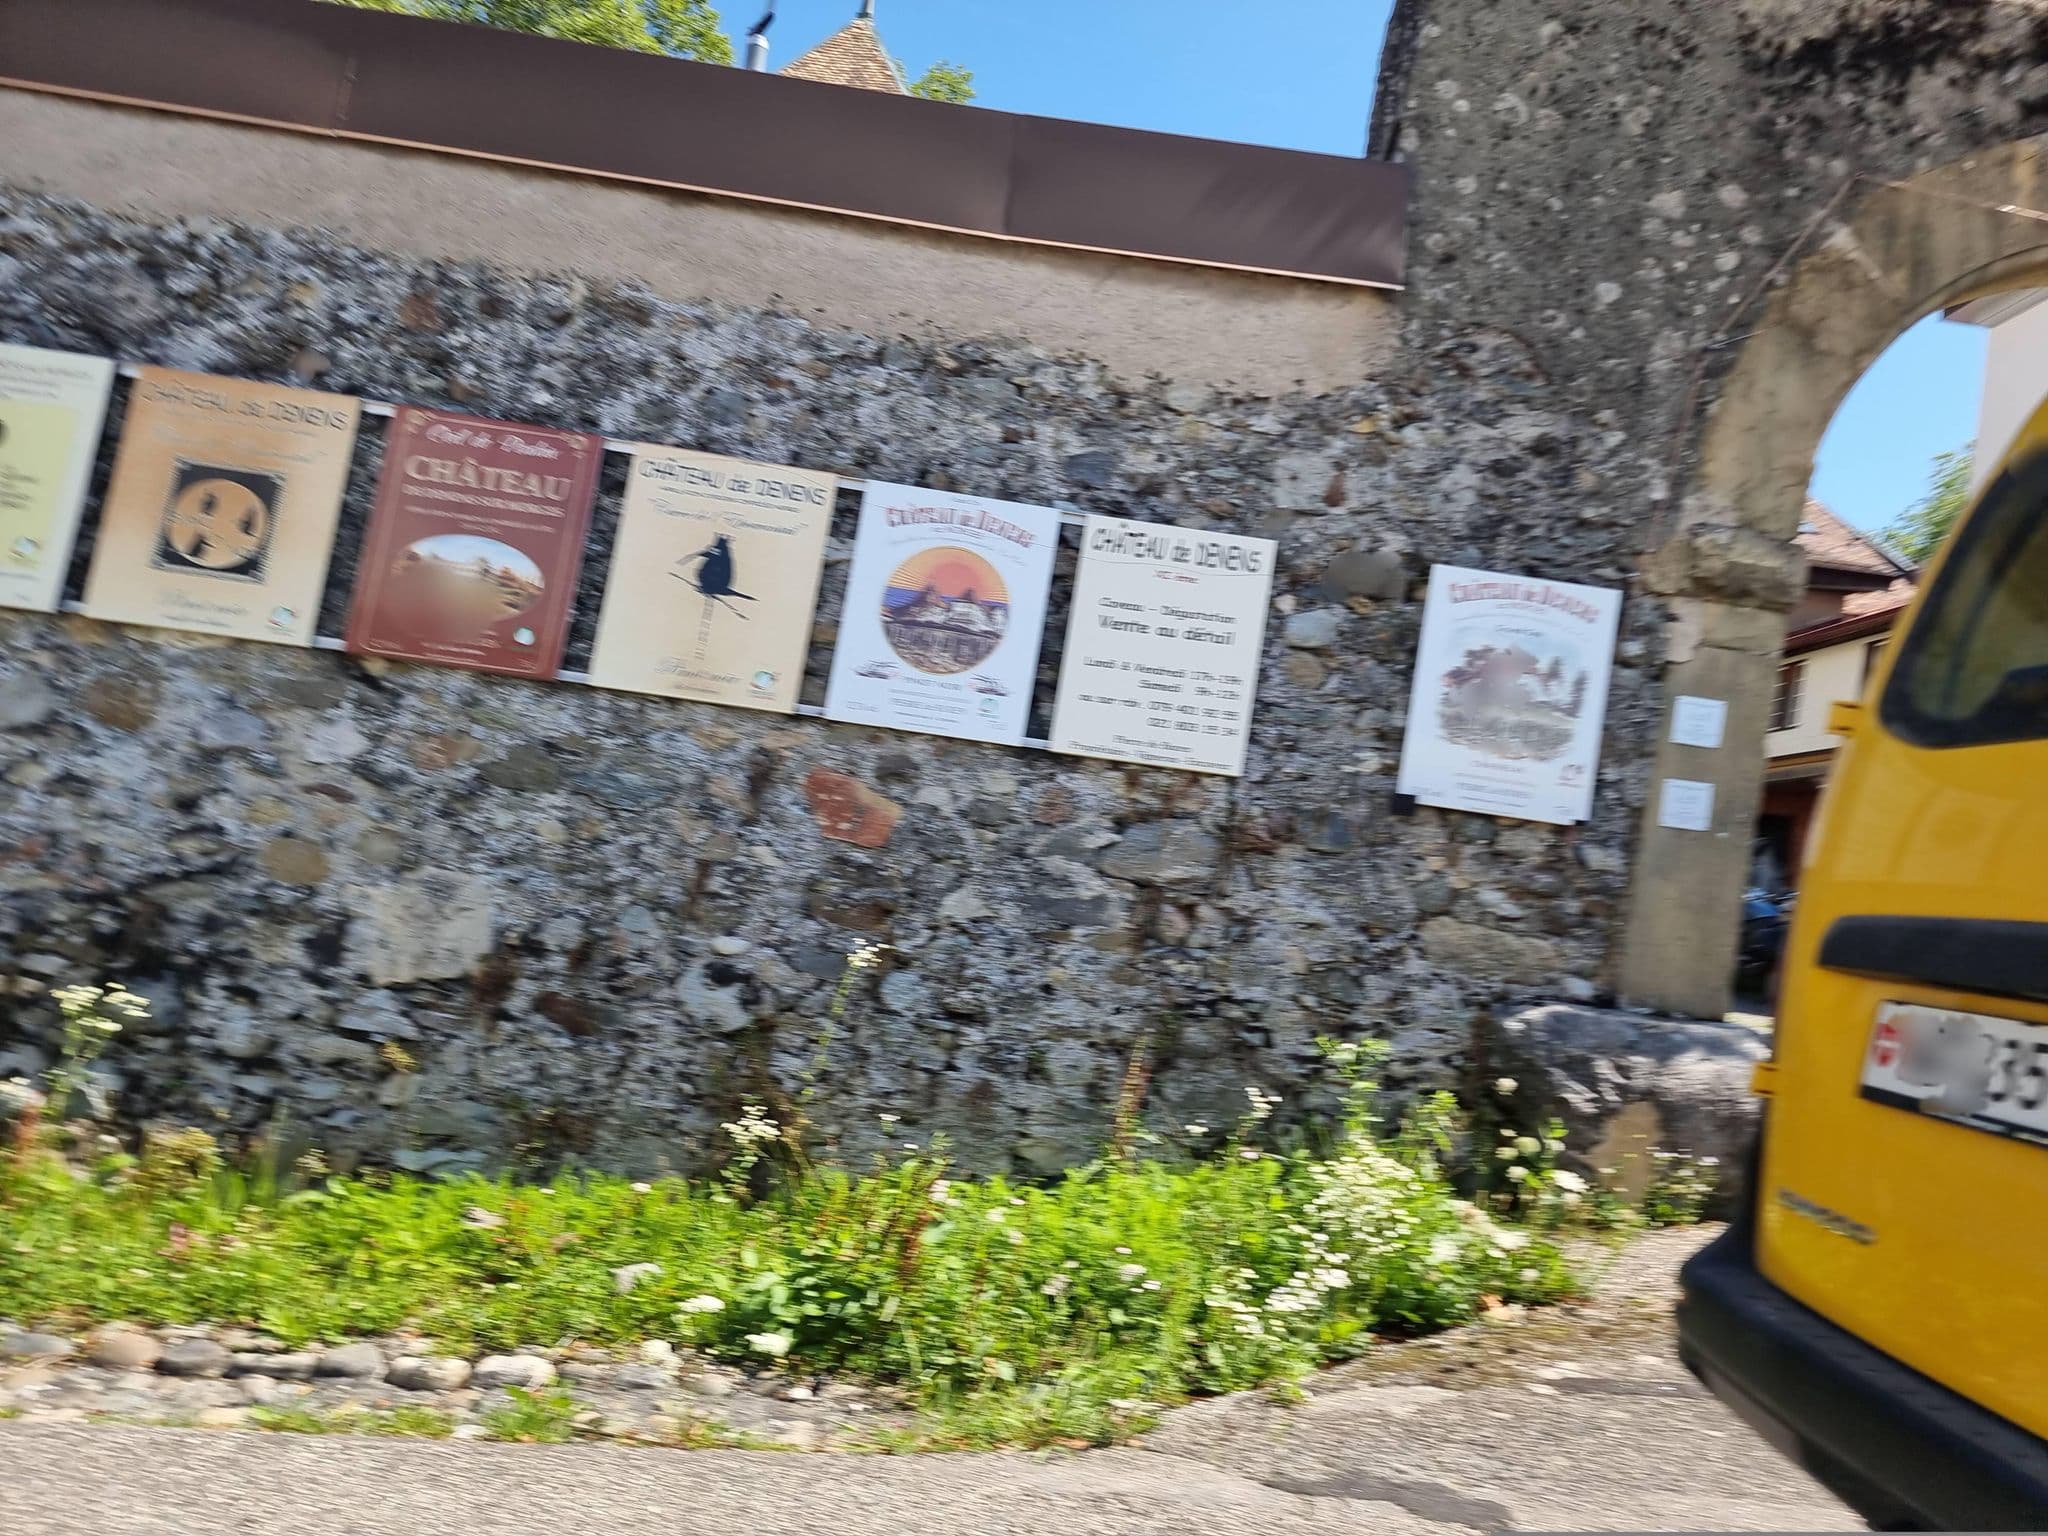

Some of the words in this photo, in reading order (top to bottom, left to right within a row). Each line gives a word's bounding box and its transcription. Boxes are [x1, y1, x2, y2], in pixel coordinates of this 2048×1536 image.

[404, 455, 572, 501] CHÂTEAU
[639, 457, 725, 489] CHÂTEAU
[727, 473, 750, 494] de
[757, 478, 828, 506] DENENS
[1090, 522, 1168, 560] CHÂTEAU
[1170, 538, 1192, 563] de
[1194, 542, 1263, 573] DENENS
[1098, 615, 1150, 633] Vente
[1156, 626, 1177, 637] au
[1183, 626, 1235, 645] détail
